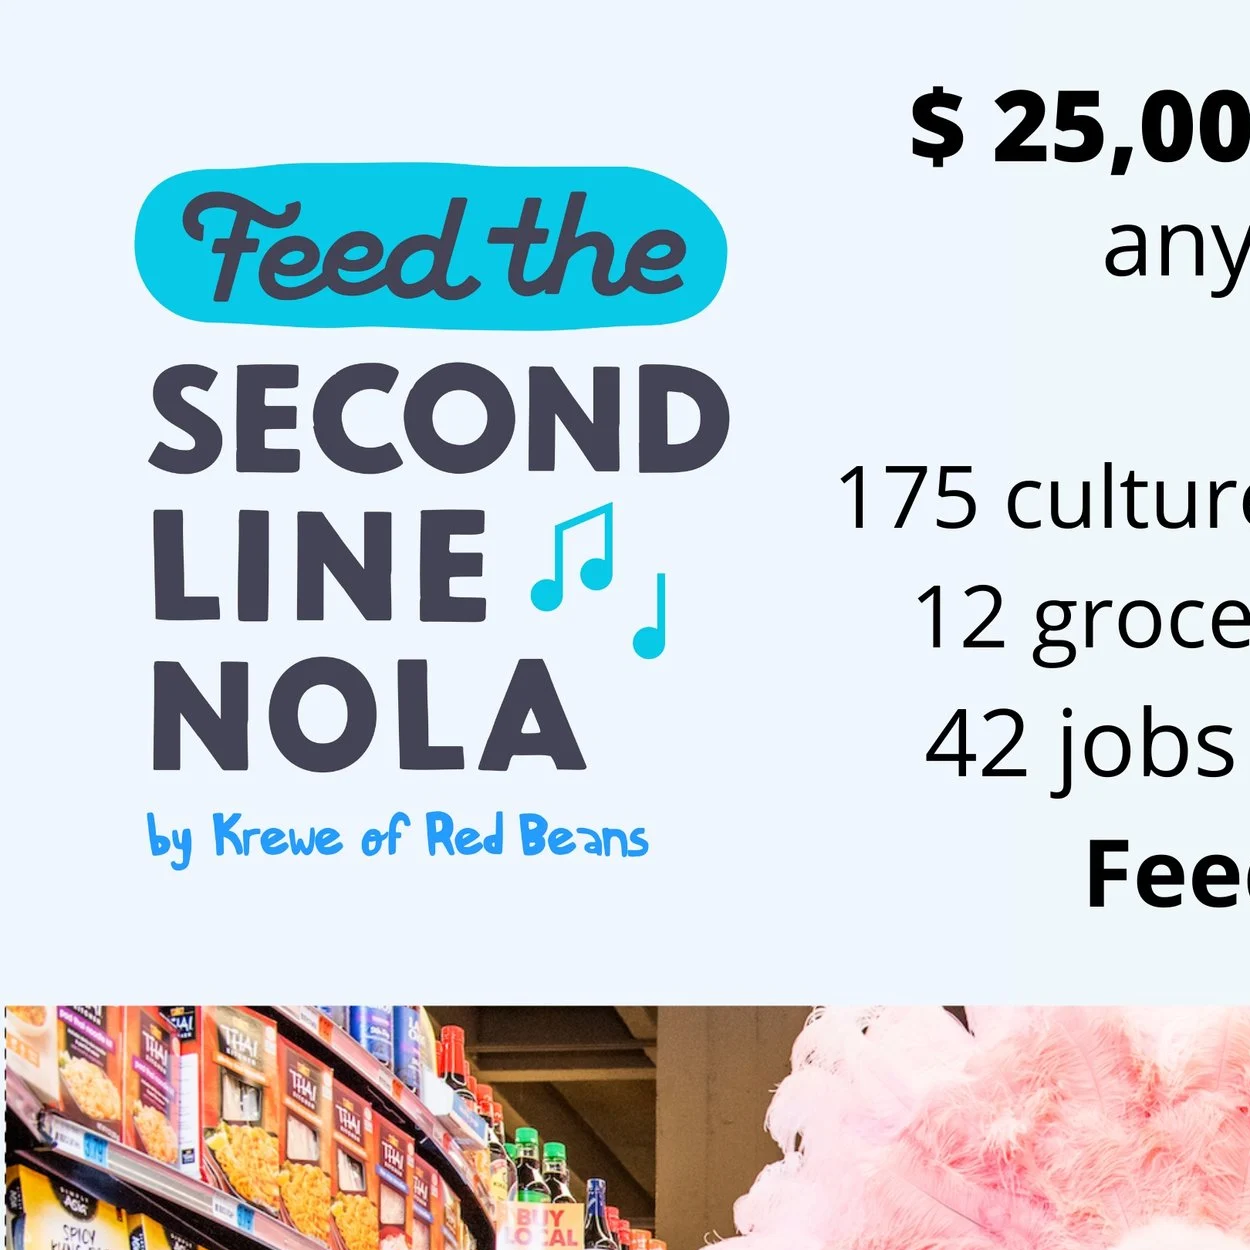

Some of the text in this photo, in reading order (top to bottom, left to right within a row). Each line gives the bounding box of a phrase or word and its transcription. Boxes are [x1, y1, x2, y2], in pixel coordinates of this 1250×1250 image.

[219, 1024, 258, 1057] THAI
[289, 1068, 317, 1101] THAI
[336, 1104, 361, 1134] THAI
[381, 1140, 404, 1170] THAI
[517, 1208, 565, 1227] BUY
[63, 1224, 96, 1245] SPICY
[504, 1227, 578, 1247] LOCAL
